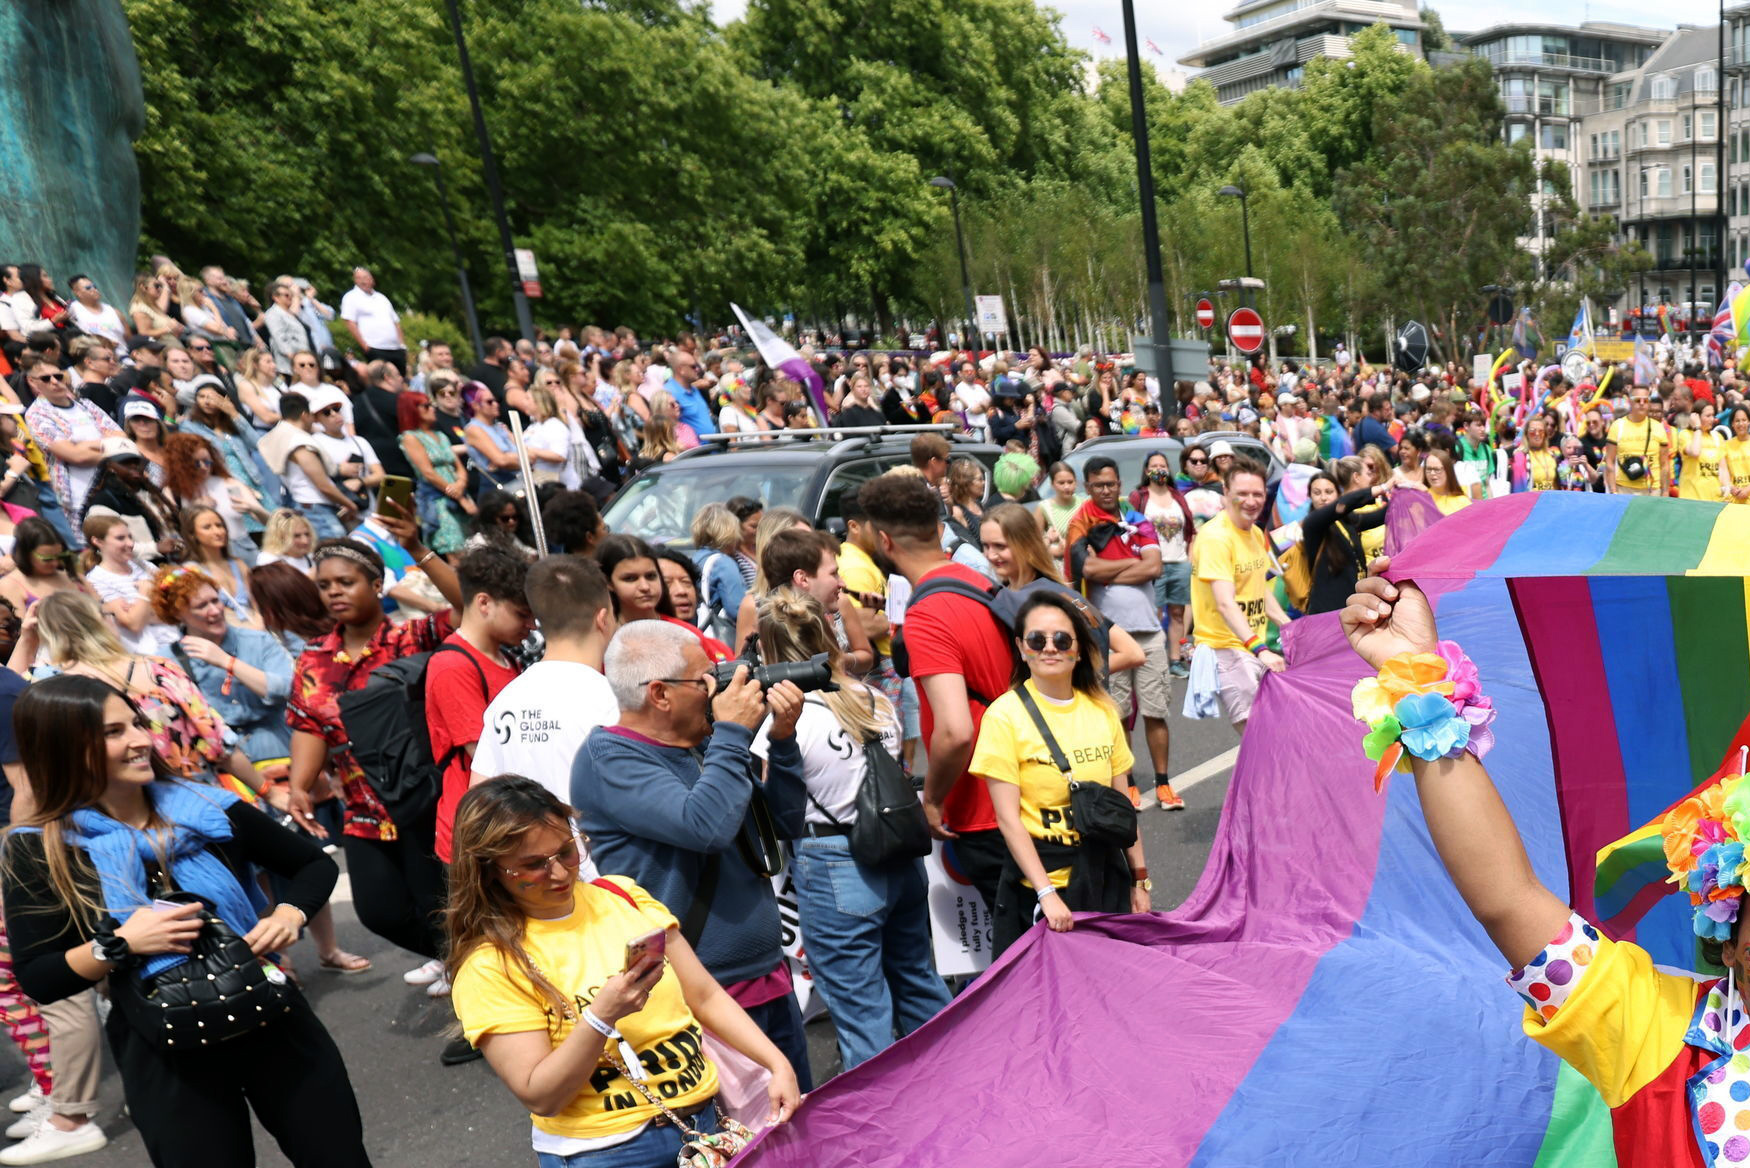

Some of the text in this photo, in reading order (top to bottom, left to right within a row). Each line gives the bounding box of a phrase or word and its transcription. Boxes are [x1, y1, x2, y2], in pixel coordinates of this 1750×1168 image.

[521, 709, 542, 720] THE
[520, 720, 561, 732] GLOBAL
[521, 732, 549, 744] FUND
[956, 895, 964, 908] to
[958, 909, 970, 948] pledge
[968, 901, 982, 953] fully fund
[603, 1091, 638, 1113] IN
